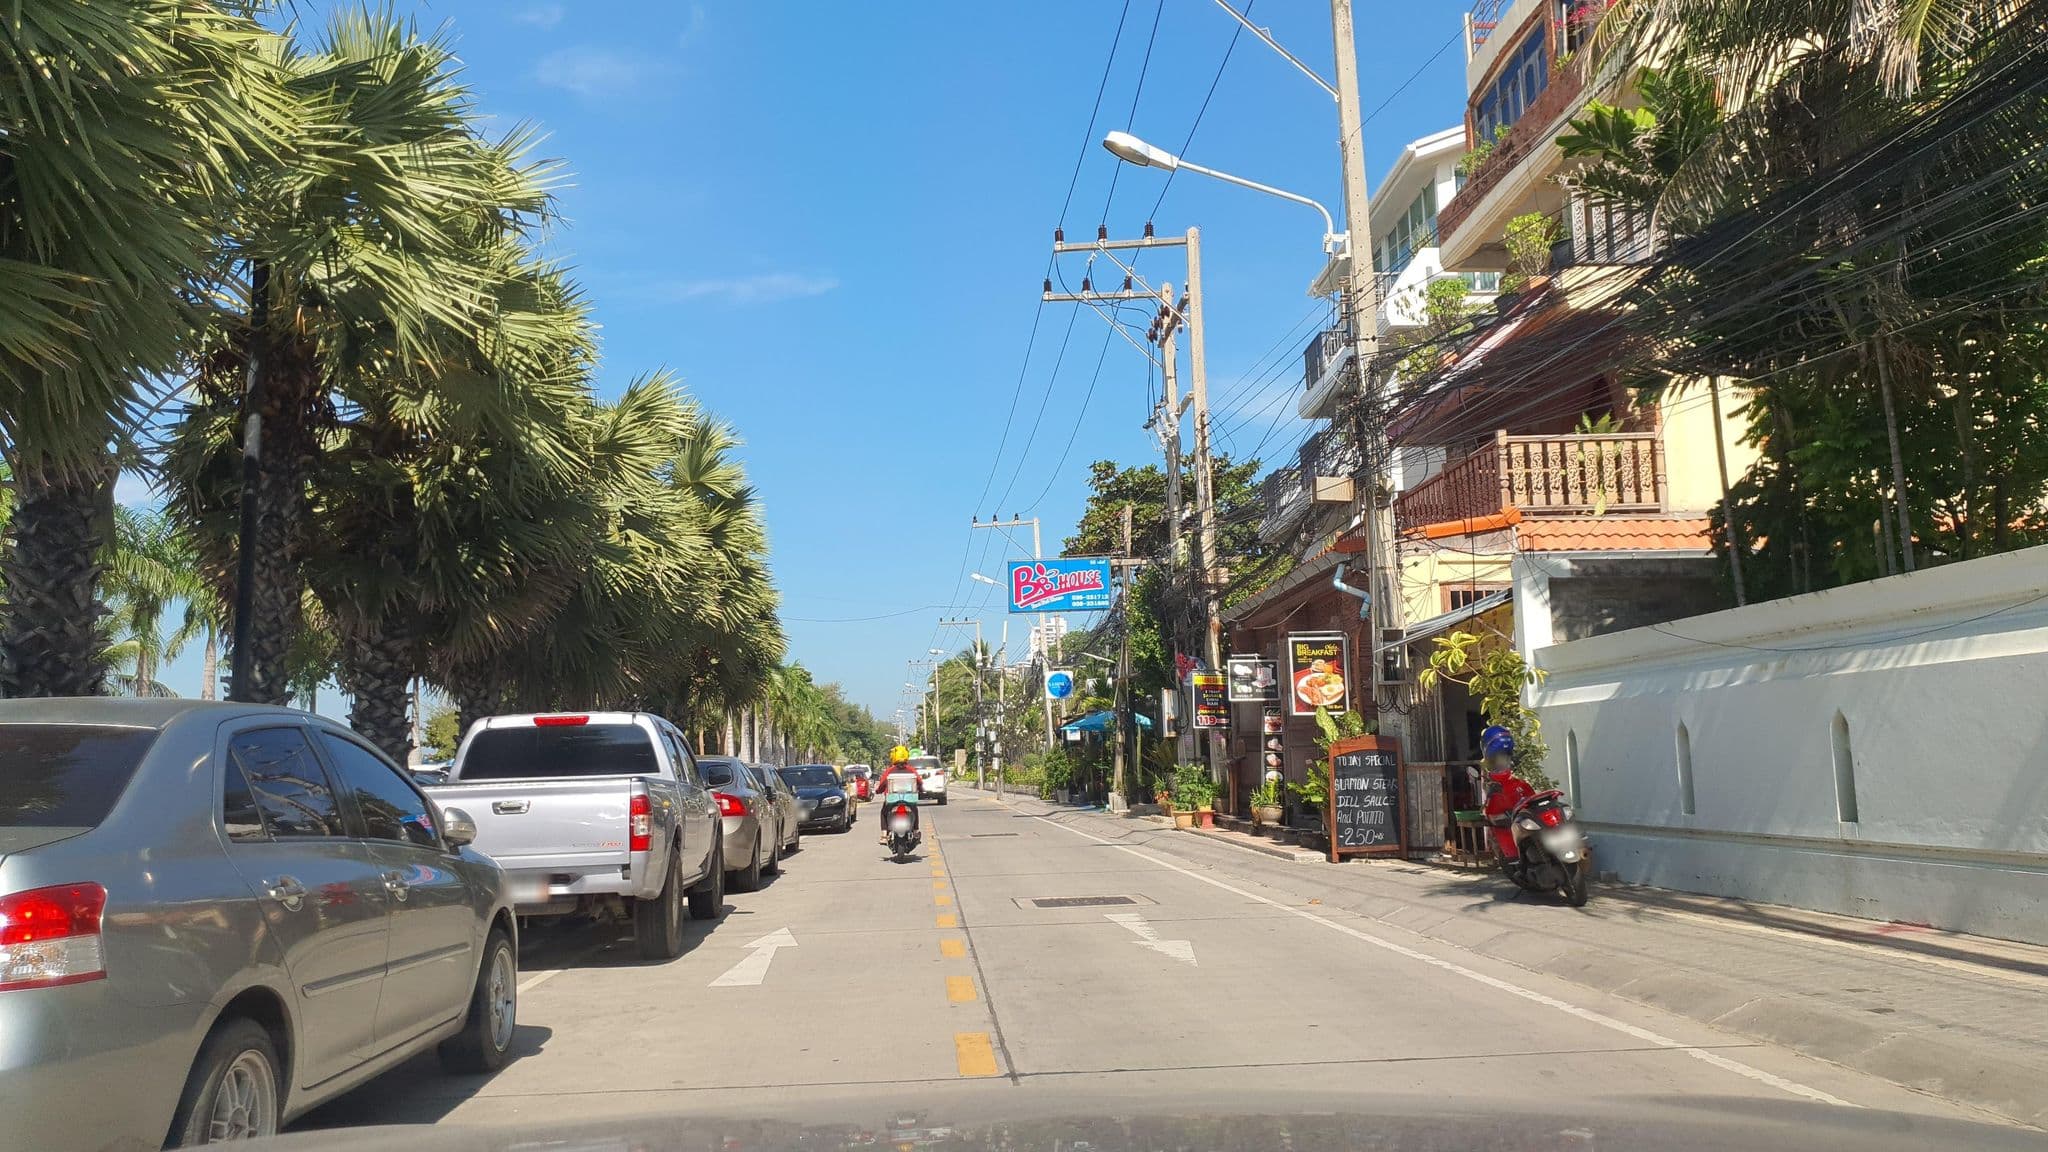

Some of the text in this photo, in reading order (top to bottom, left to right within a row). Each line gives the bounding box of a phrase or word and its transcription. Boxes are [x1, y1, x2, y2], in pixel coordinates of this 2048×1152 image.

[1058, 570, 1101, 589] HOUSE
[1197, 715, 1217, 725] 119
[1365, 755, 1396, 766] SPECIAL
[1372, 778, 1399, 790] STEAK
[1336, 795, 1396, 808] DILL SAUCE
